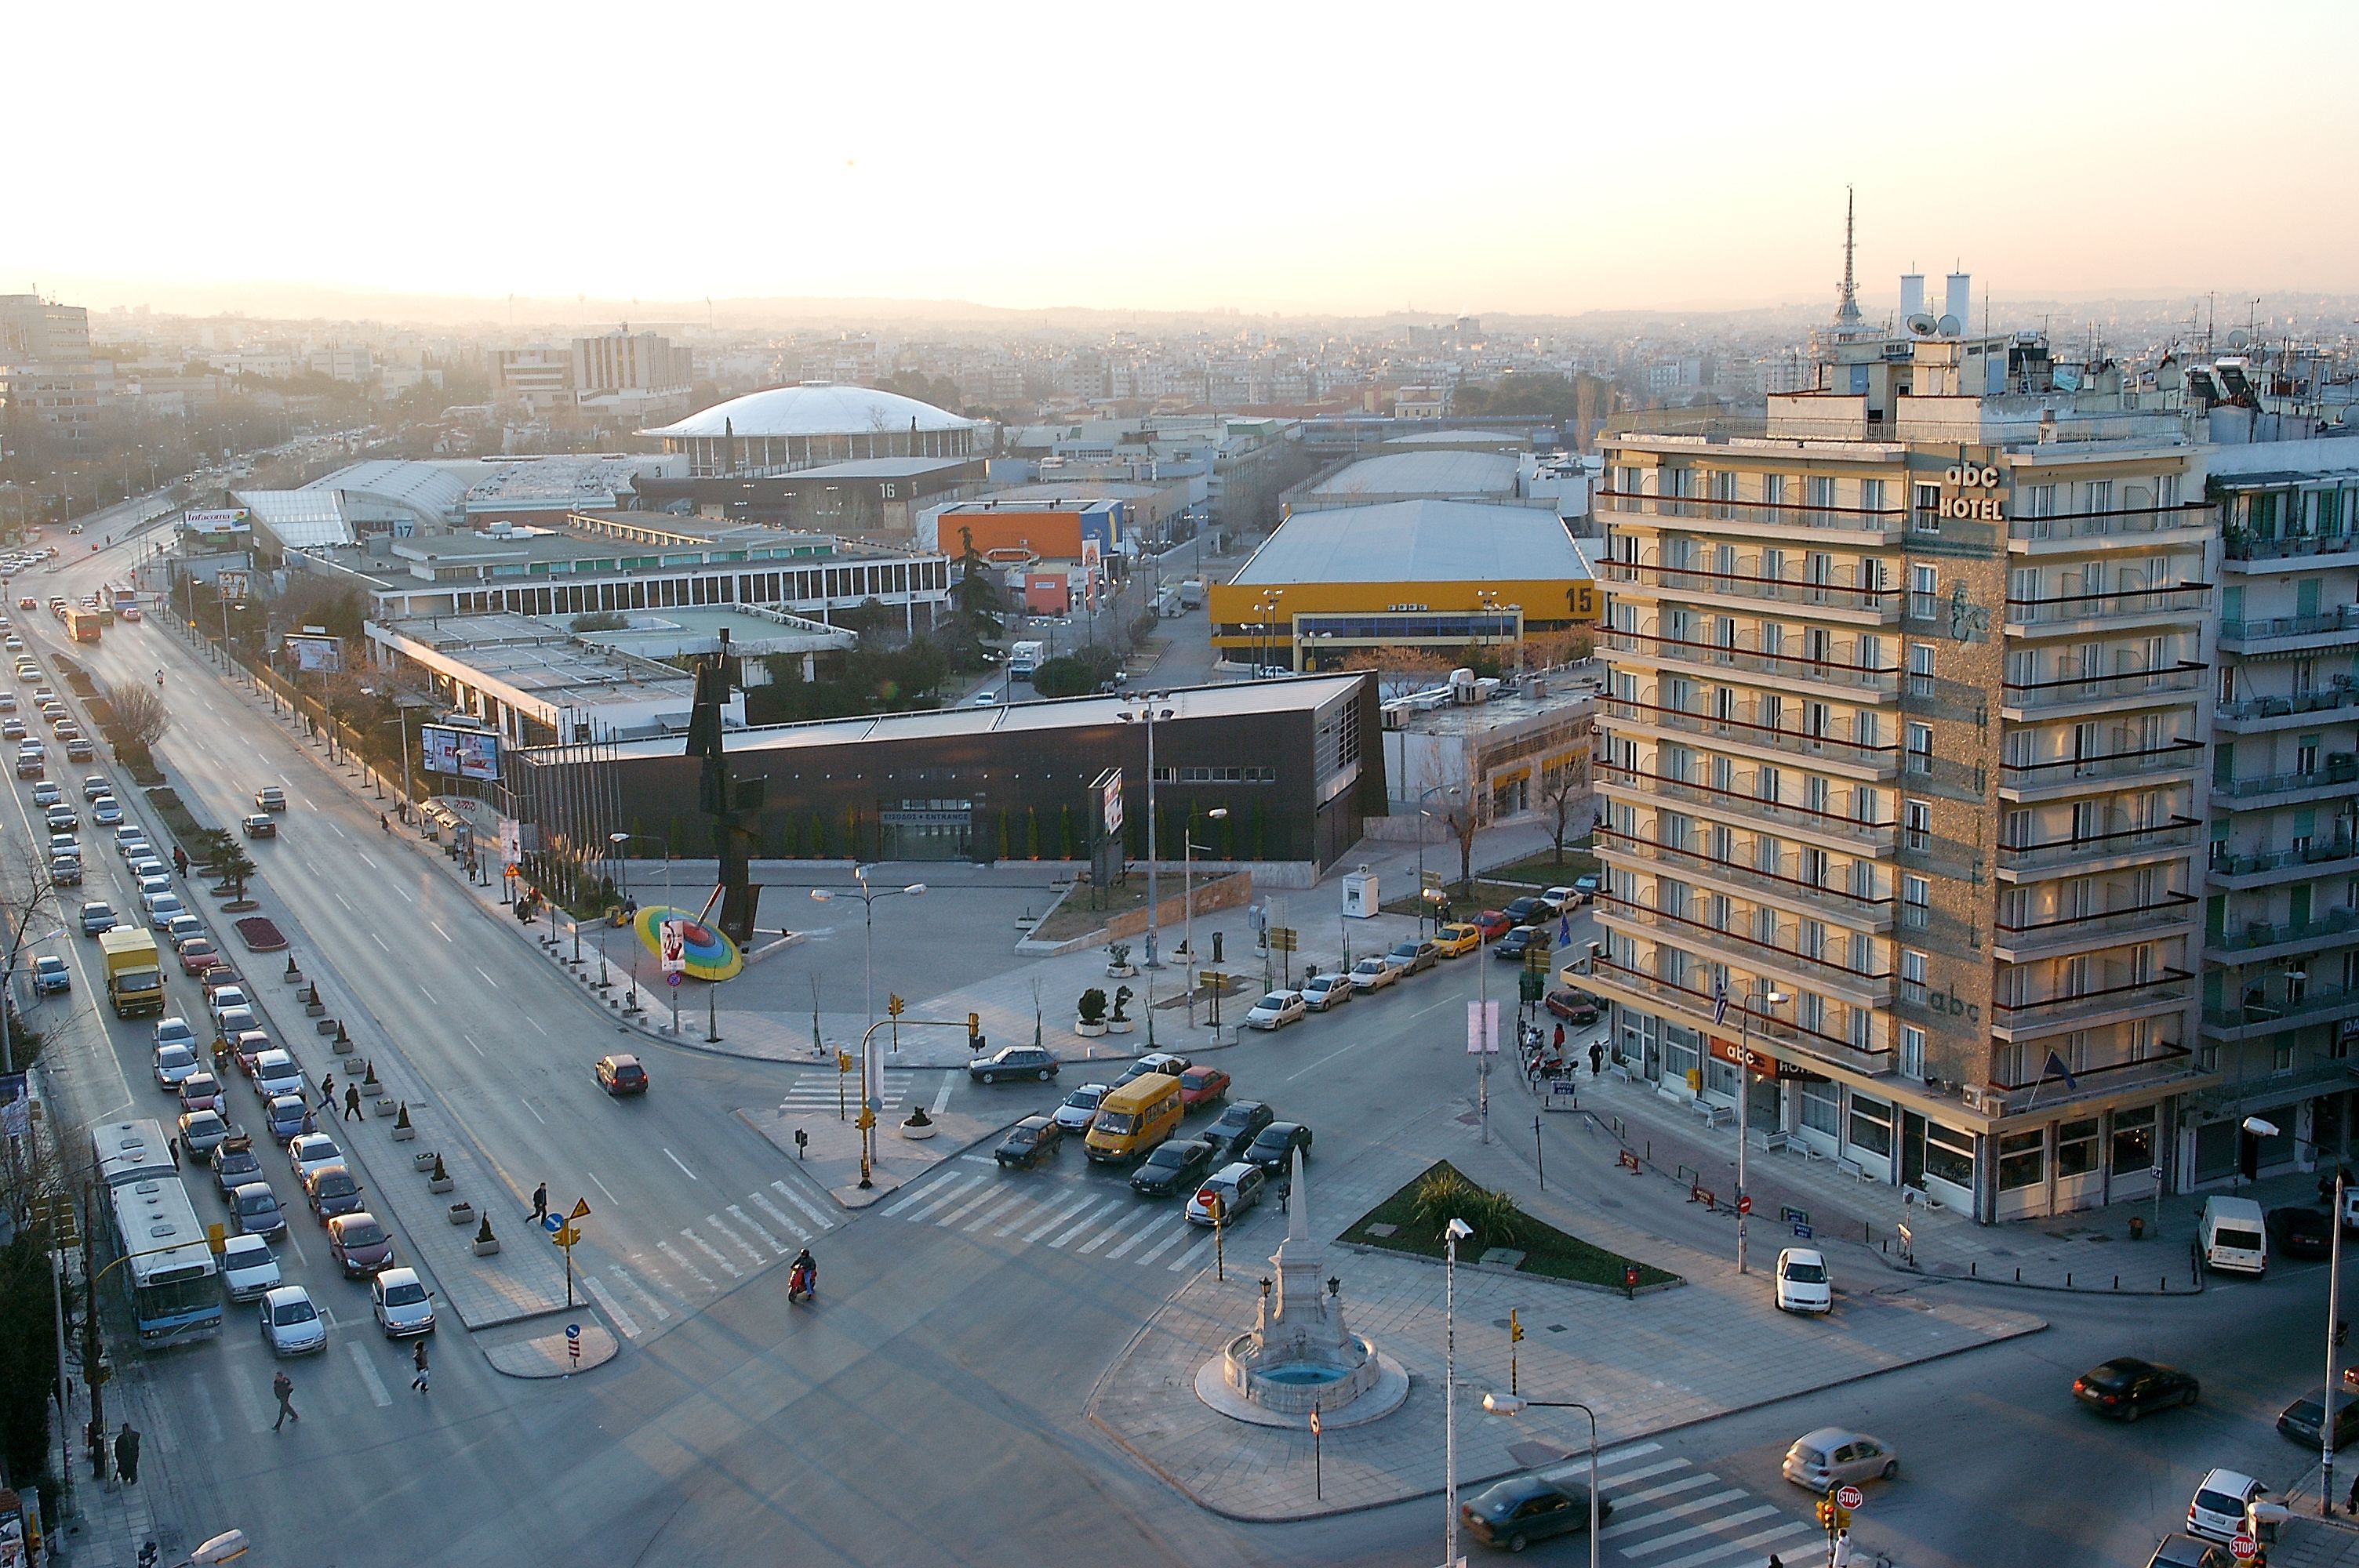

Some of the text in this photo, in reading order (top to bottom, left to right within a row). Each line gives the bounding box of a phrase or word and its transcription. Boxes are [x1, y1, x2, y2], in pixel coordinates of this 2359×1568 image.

[1945, 461, 1998, 488] abc
[879, 483, 895, 499] 16
[1939, 497, 2004, 521] HOTEL
[398, 526, 413, 538] 17
[1566, 588, 1591, 612] 15
[1930, 982, 1979, 1022] abc
[1727, 1045, 1754, 1065] abc
[1840, 1491, 1860, 1504] STOP
[2232, 1541, 2255, 1553] STOP
